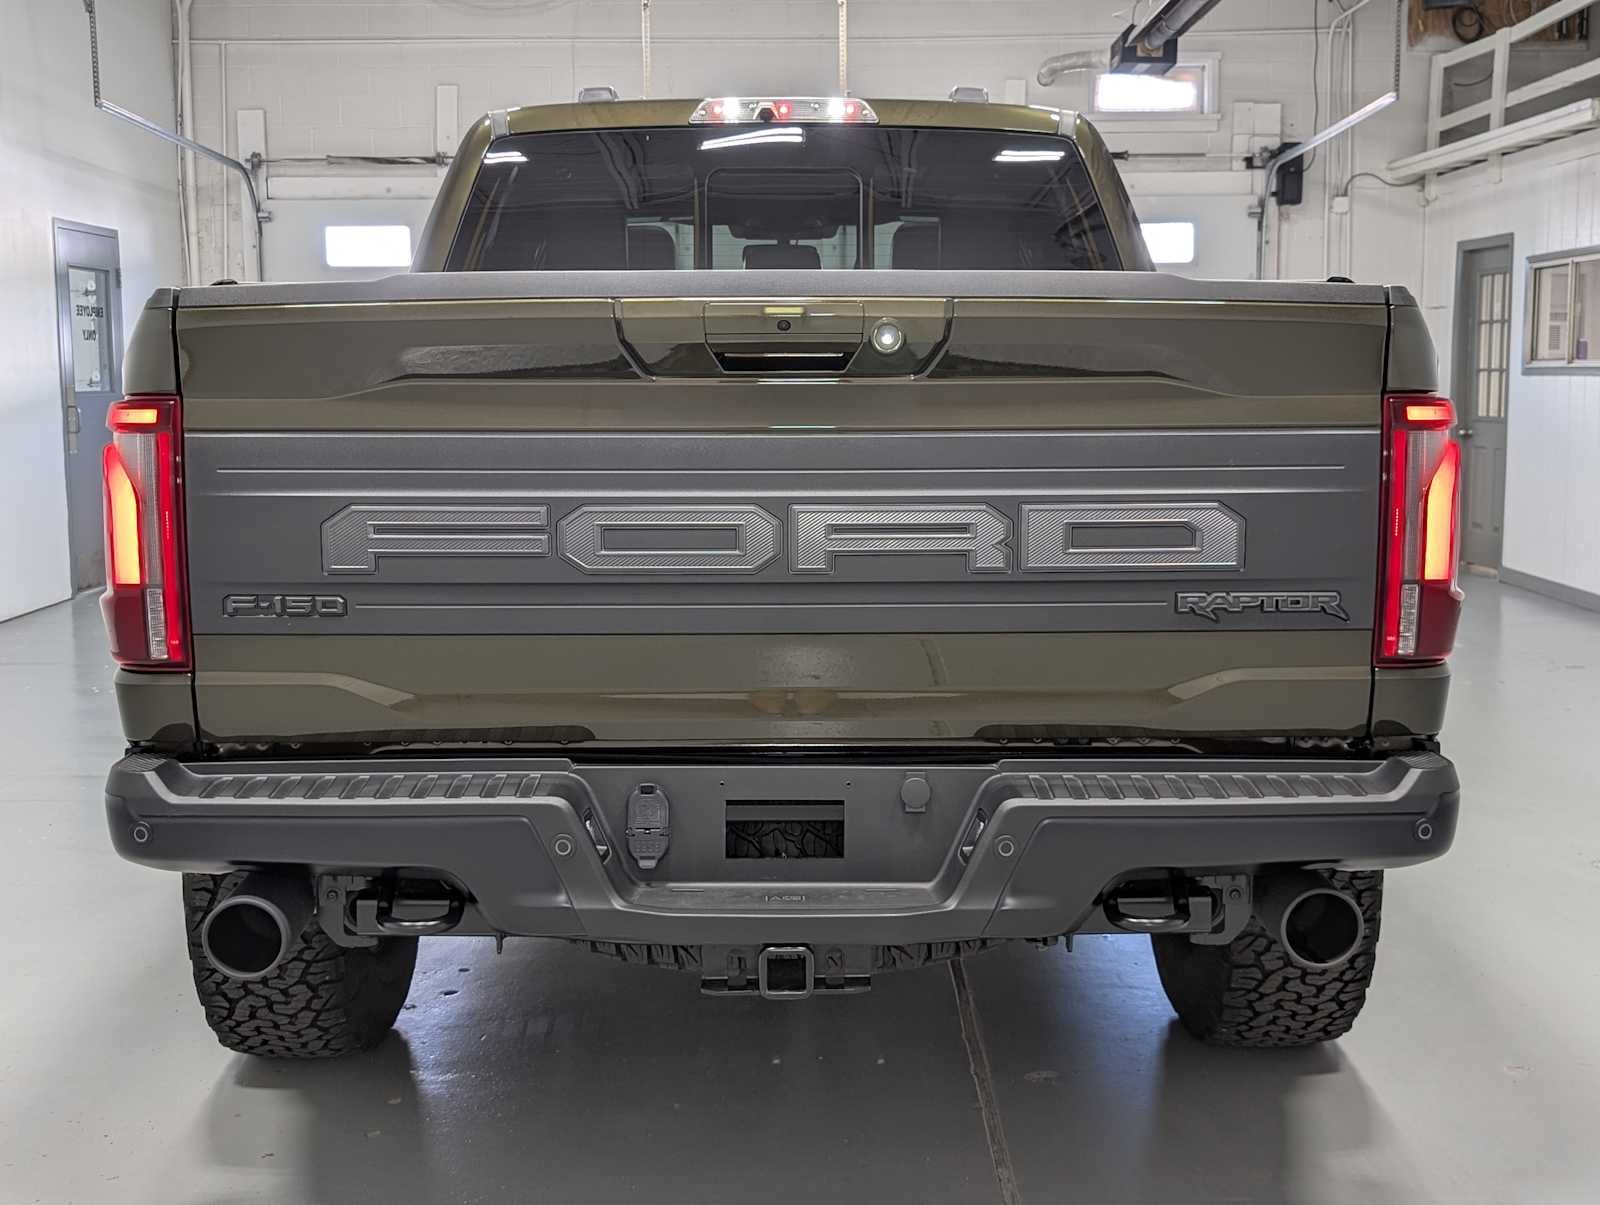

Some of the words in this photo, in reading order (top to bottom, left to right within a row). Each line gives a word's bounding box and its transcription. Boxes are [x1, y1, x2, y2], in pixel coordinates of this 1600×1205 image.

[321, 500, 1247, 575] FORD
[223, 594, 348, 616] F-150
[1175, 591, 1350, 623] RAPTOR
